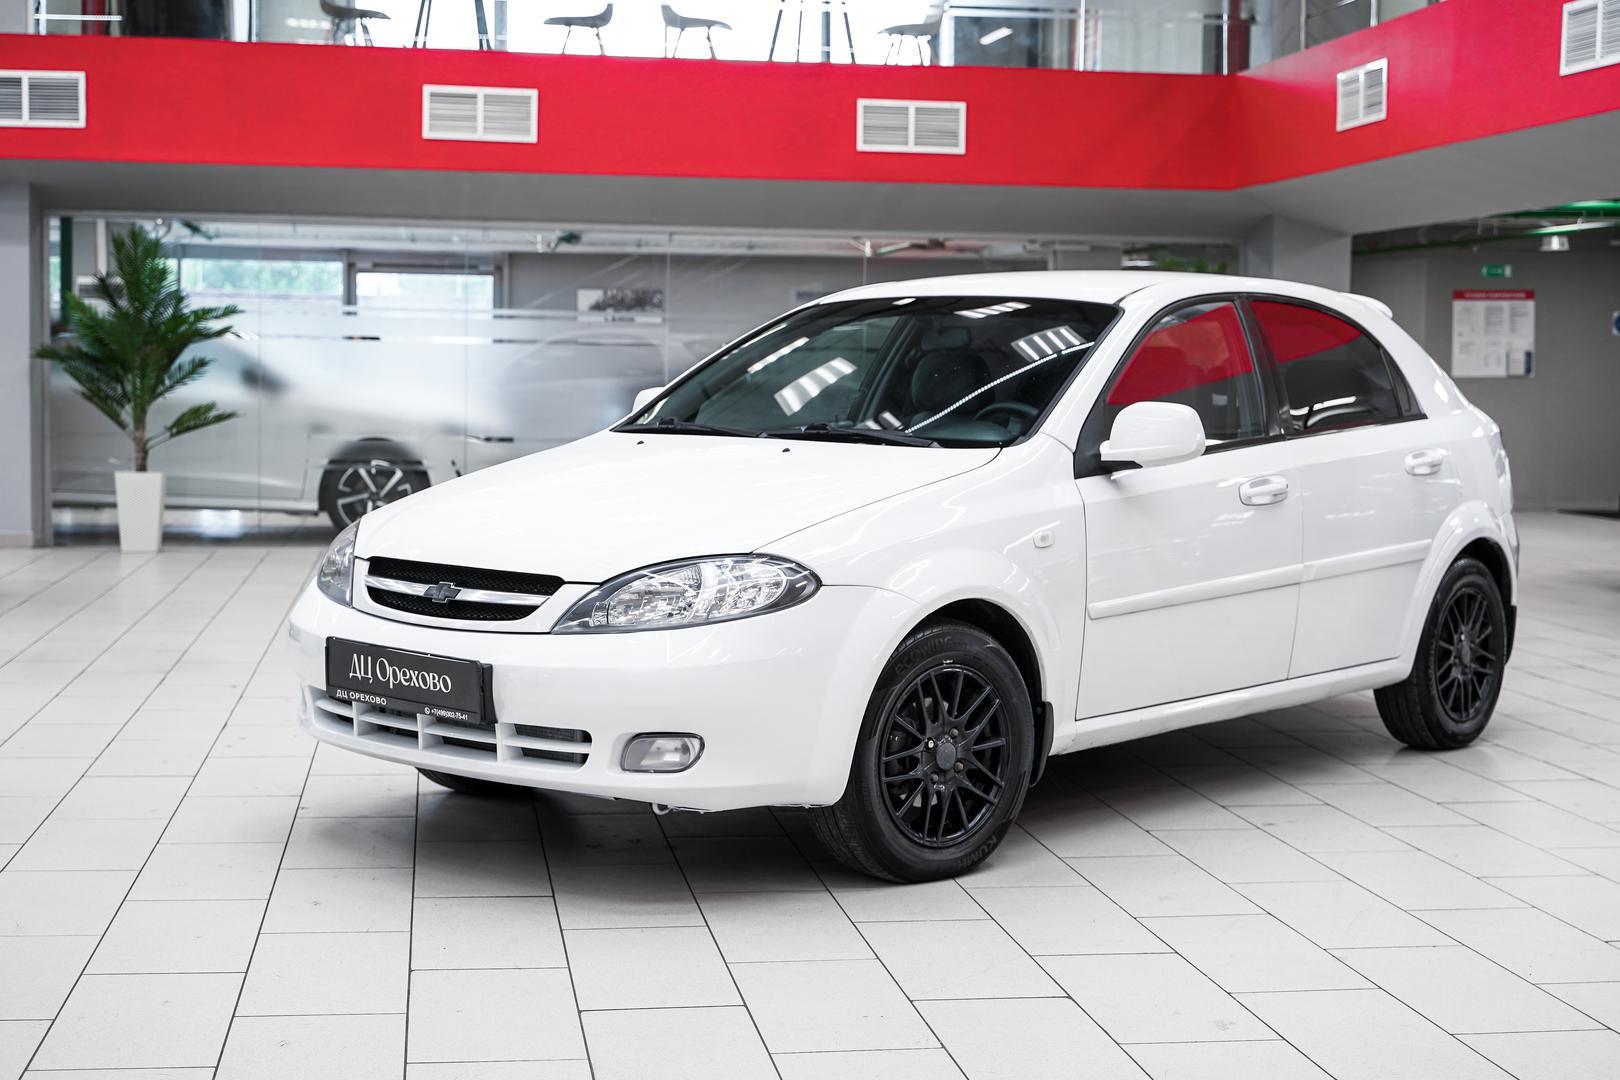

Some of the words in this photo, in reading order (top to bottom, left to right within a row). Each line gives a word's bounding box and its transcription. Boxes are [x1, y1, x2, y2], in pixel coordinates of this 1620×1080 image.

[349, 653, 373, 684] ДЦ
[376, 657, 452, 693] Орехово
[336, 689, 348, 699] ДЦ
[349, 691, 387, 706] ОРЕХОВО
[960, 835, 997, 867] KUMH
